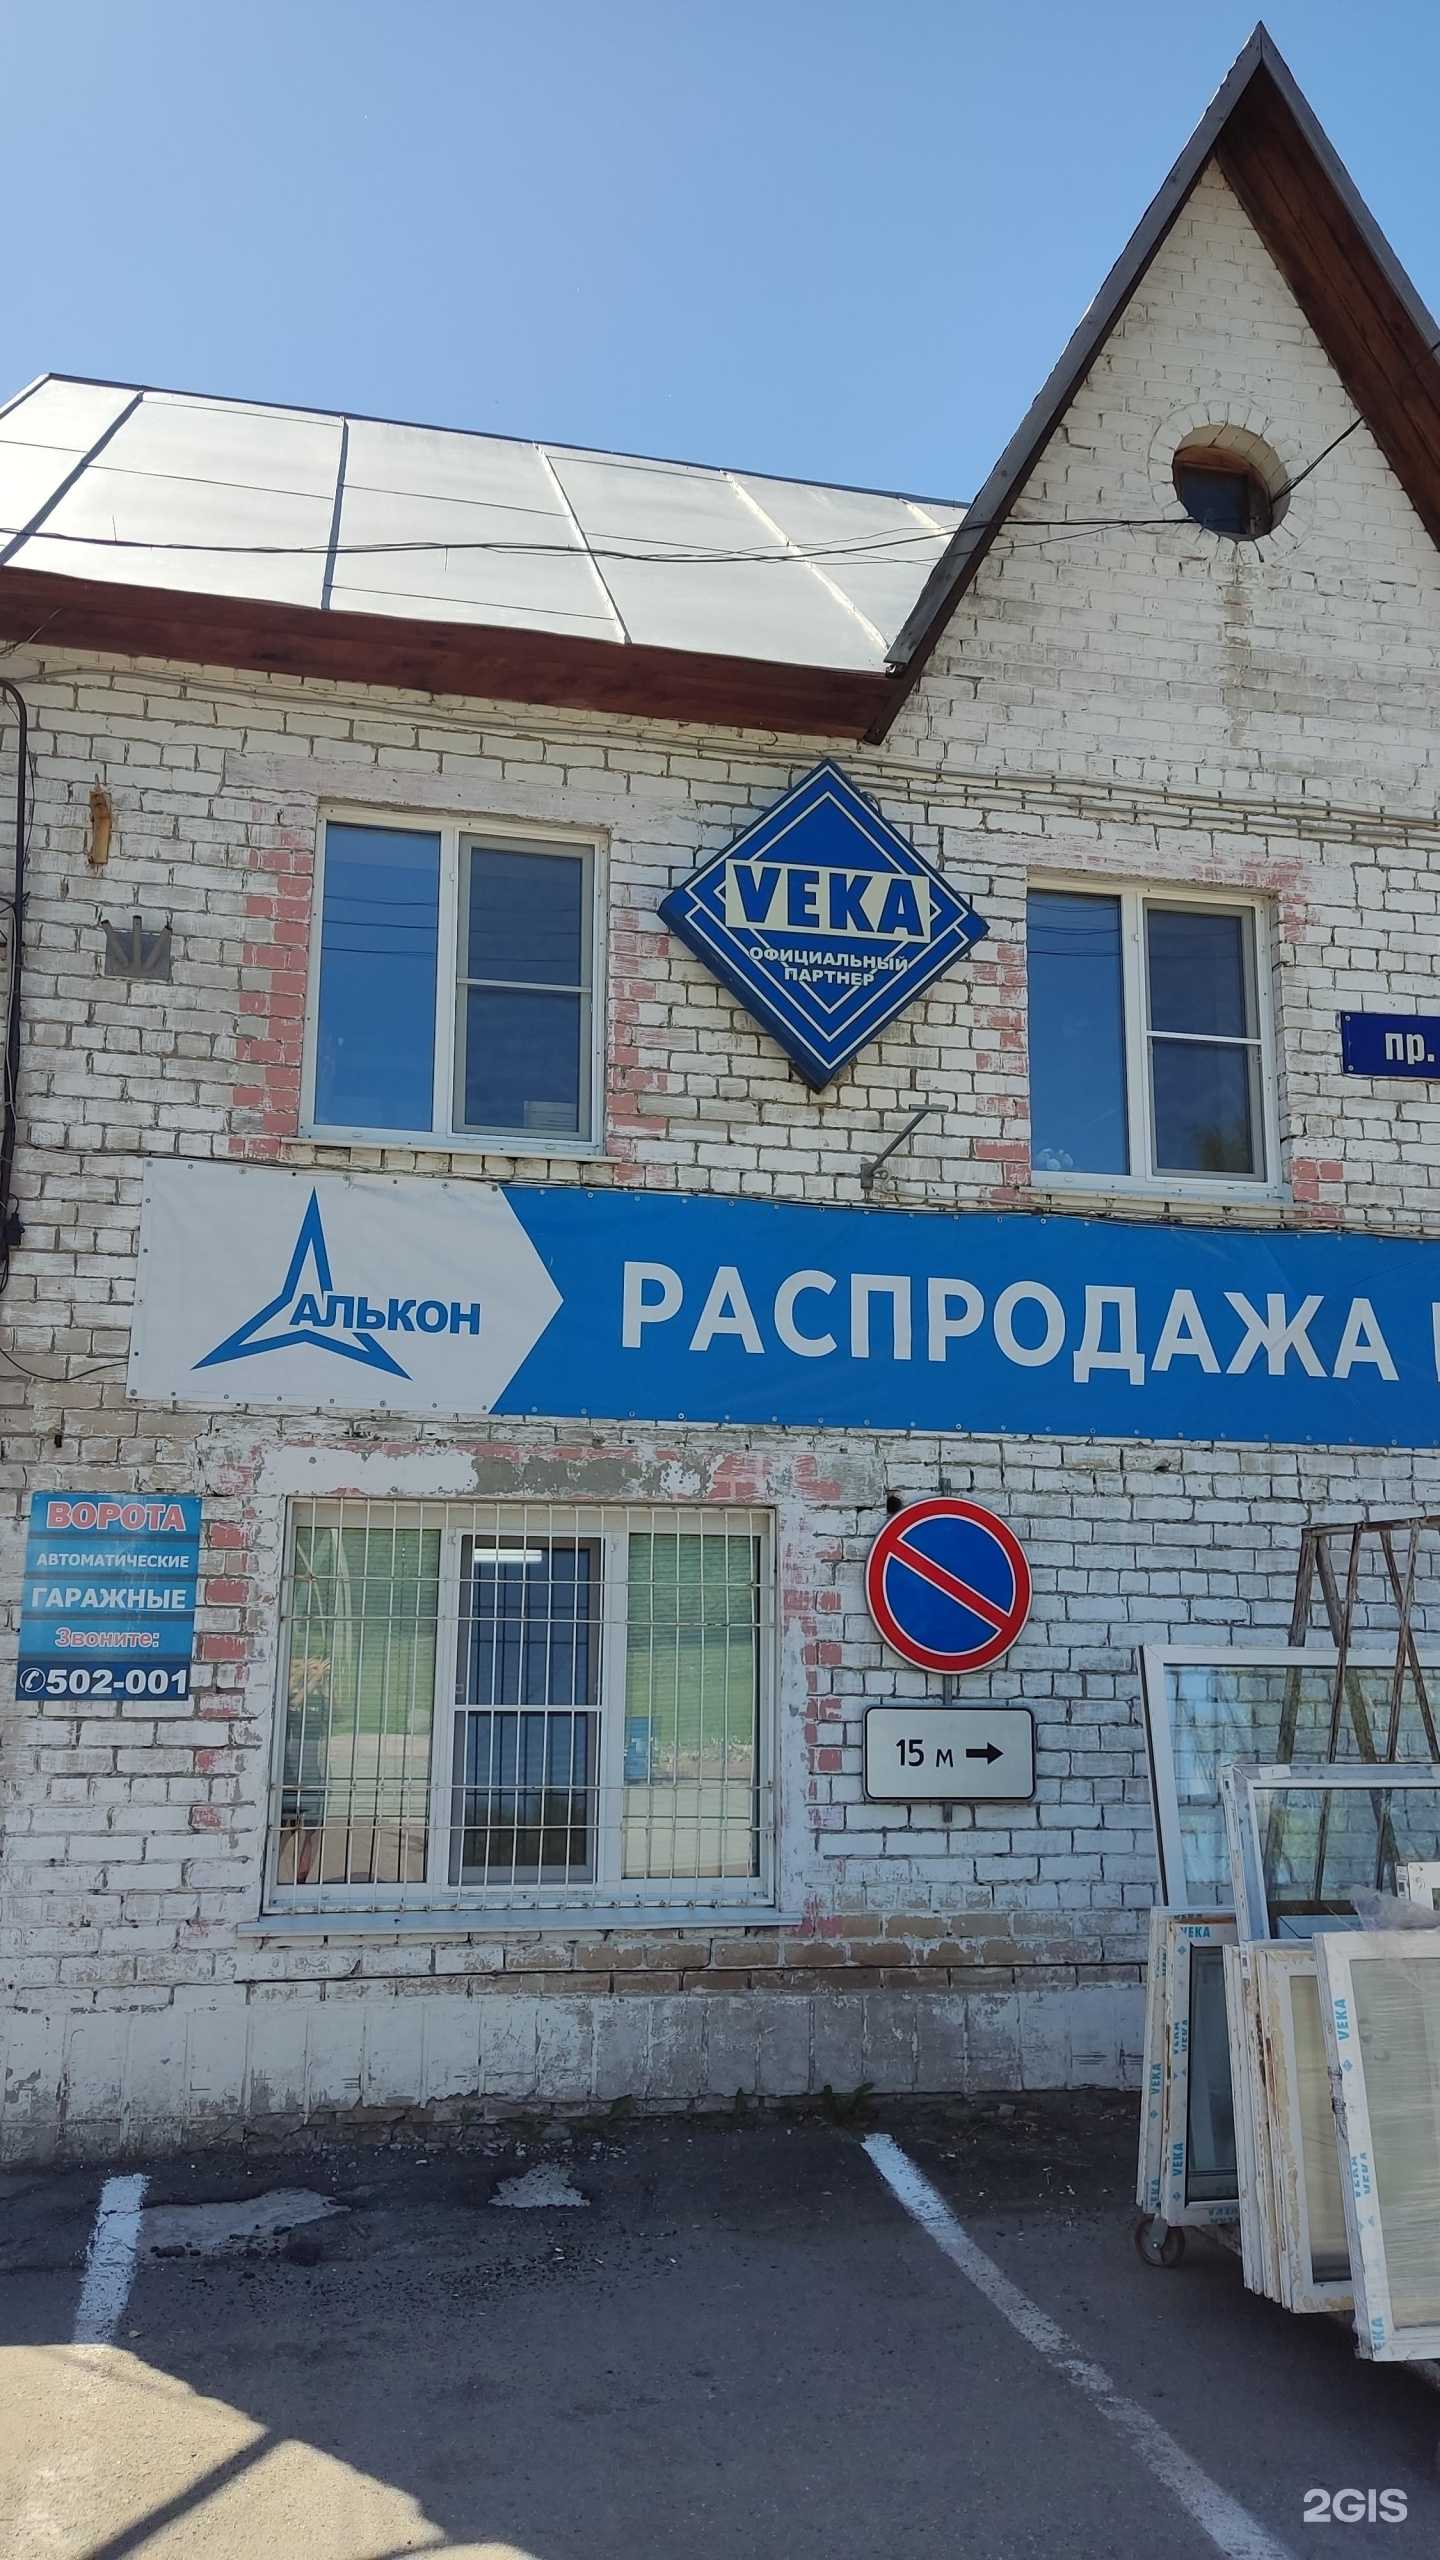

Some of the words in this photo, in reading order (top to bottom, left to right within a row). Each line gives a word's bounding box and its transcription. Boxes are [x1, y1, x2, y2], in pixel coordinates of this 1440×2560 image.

[733, 865, 925, 936] VEKA
[750, 947, 909, 971] ОФИЦИАЛЬНЫЙ
[784, 967, 875, 987] ПАРТНЕР
[1385, 1032, 1435, 1065] пр.
[289, 1293, 481, 1335] АЛЬКОН
[622, 1261, 1400, 1386] РАСПРОДАЖА
[47, 1501, 186, 1532] ВОРОТА
[36, 1553, 190, 1568] АВТОМАТИЧЕСКИЕ
[31, 1587, 187, 1609] ГАРАЖНЫЕ
[54, 1626, 160, 1648] Звоните:
[46, 1669, 188, 1695] 502-001
[896, 1739, 924, 1767] 15
[1334, 1999, 1349, 2040] VEKA
[1151, 2063, 1162, 2095] VEKA
[1172, 2142, 1184, 2177] VEKA
